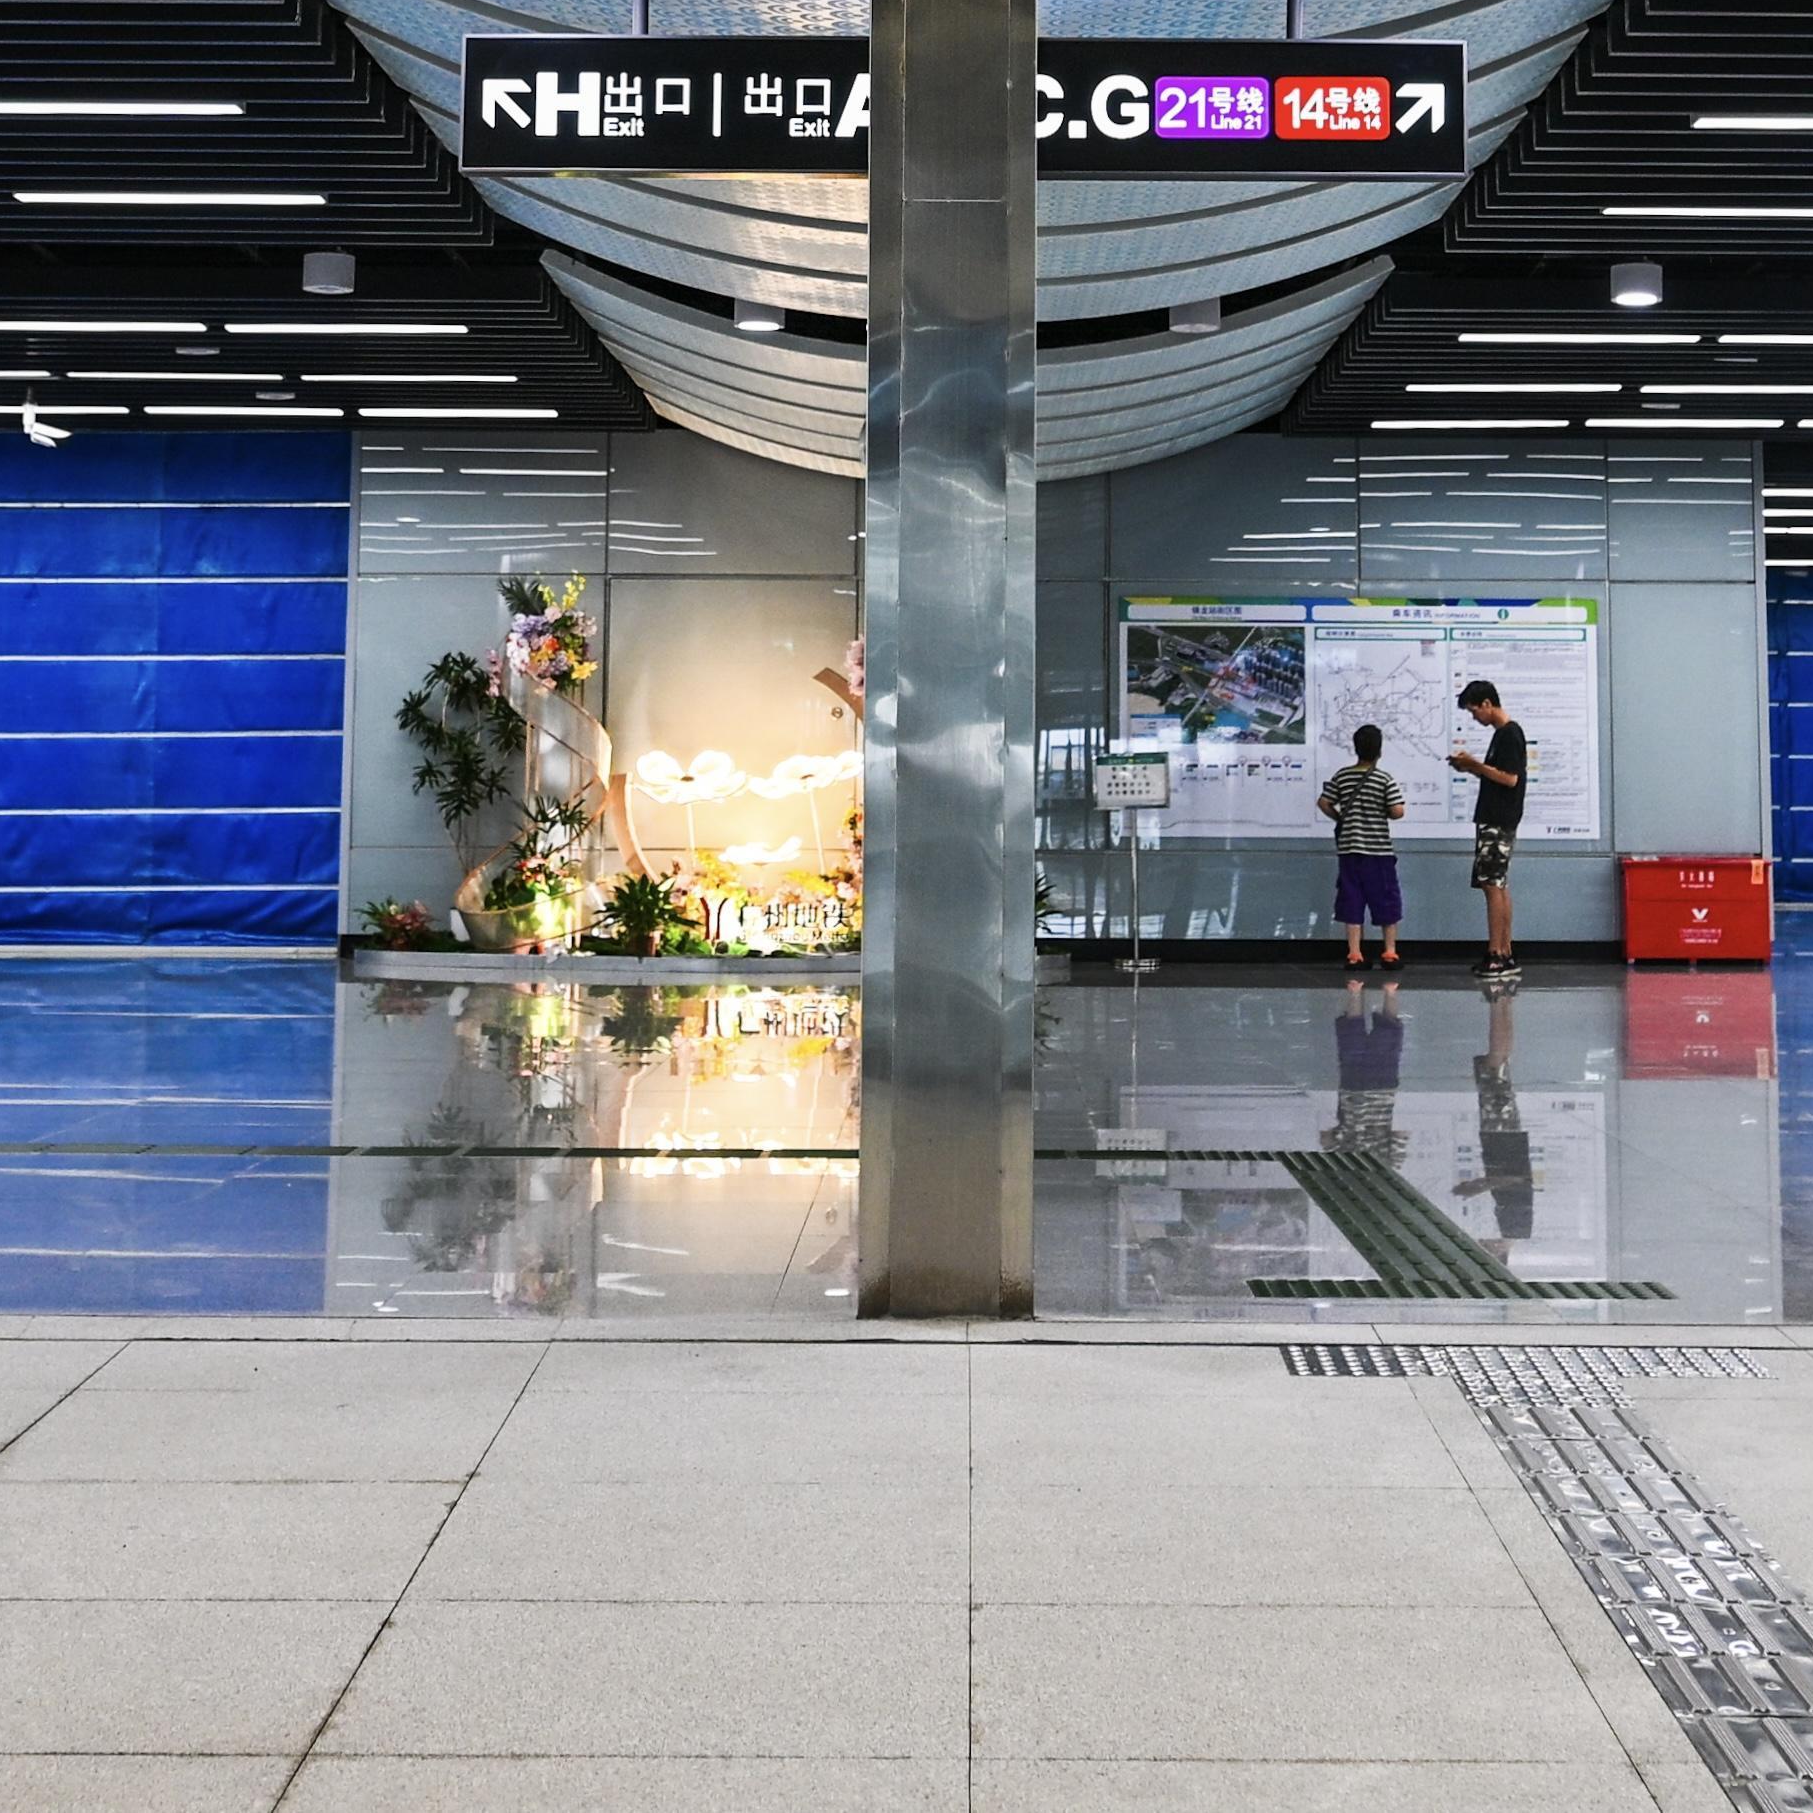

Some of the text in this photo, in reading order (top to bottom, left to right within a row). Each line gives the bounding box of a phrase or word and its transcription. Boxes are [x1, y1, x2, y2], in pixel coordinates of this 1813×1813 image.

[534, 71, 601, 137] H
[603, 72, 691, 117] 出口
[744, 72, 832, 117] 出口
[1158, 86, 1265, 130] 21号线
[1283, 86, 1382, 130] 14号线
[603, 117, 645, 138] Exit
[788, 117, 831, 138] Exit
[1210, 114, 1263, 130] Line 21
[1329, 114, 1382, 130] Line 14
